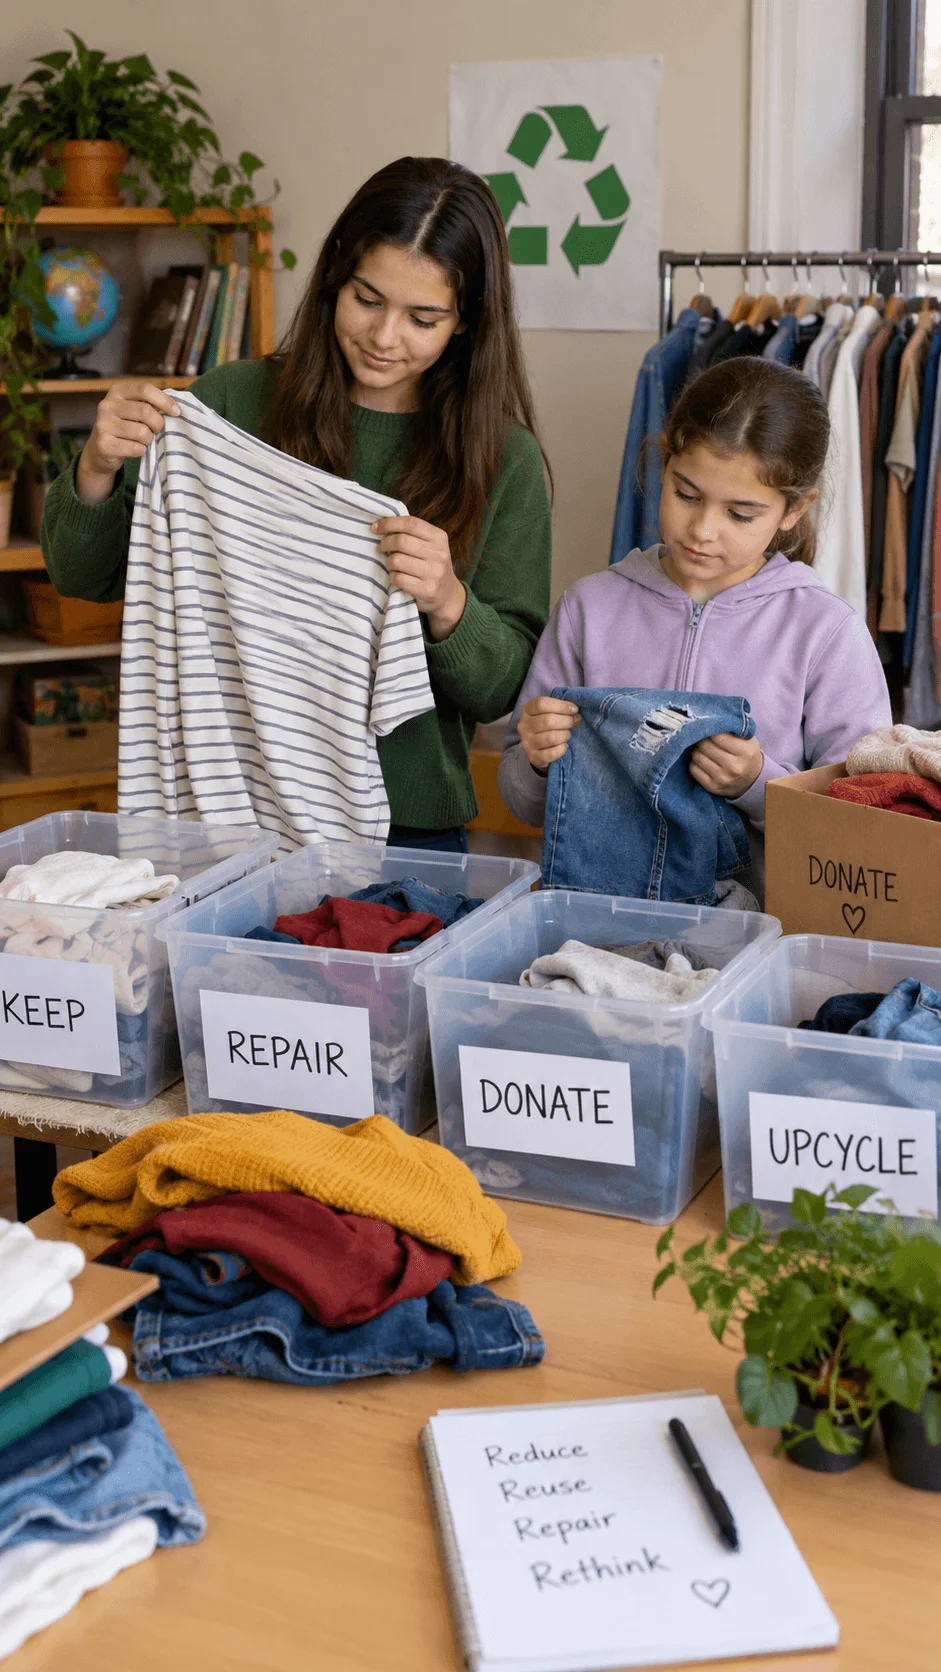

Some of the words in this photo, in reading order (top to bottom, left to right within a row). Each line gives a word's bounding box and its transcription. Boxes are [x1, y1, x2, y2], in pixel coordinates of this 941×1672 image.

[808, 854, 899, 903] DONATE
[1, 990, 85, 1033] KEEP
[227, 1030, 348, 1078] REPAIR
[479, 1078, 614, 1124] DONATE
[769, 1128, 918, 1176] UPCYCLE
[484, 1442, 588, 1467] Reduce
[499, 1478, 592, 1502] Reuse
[514, 1511, 616, 1545] Repair
[530, 1546, 670, 1591] Rethink
